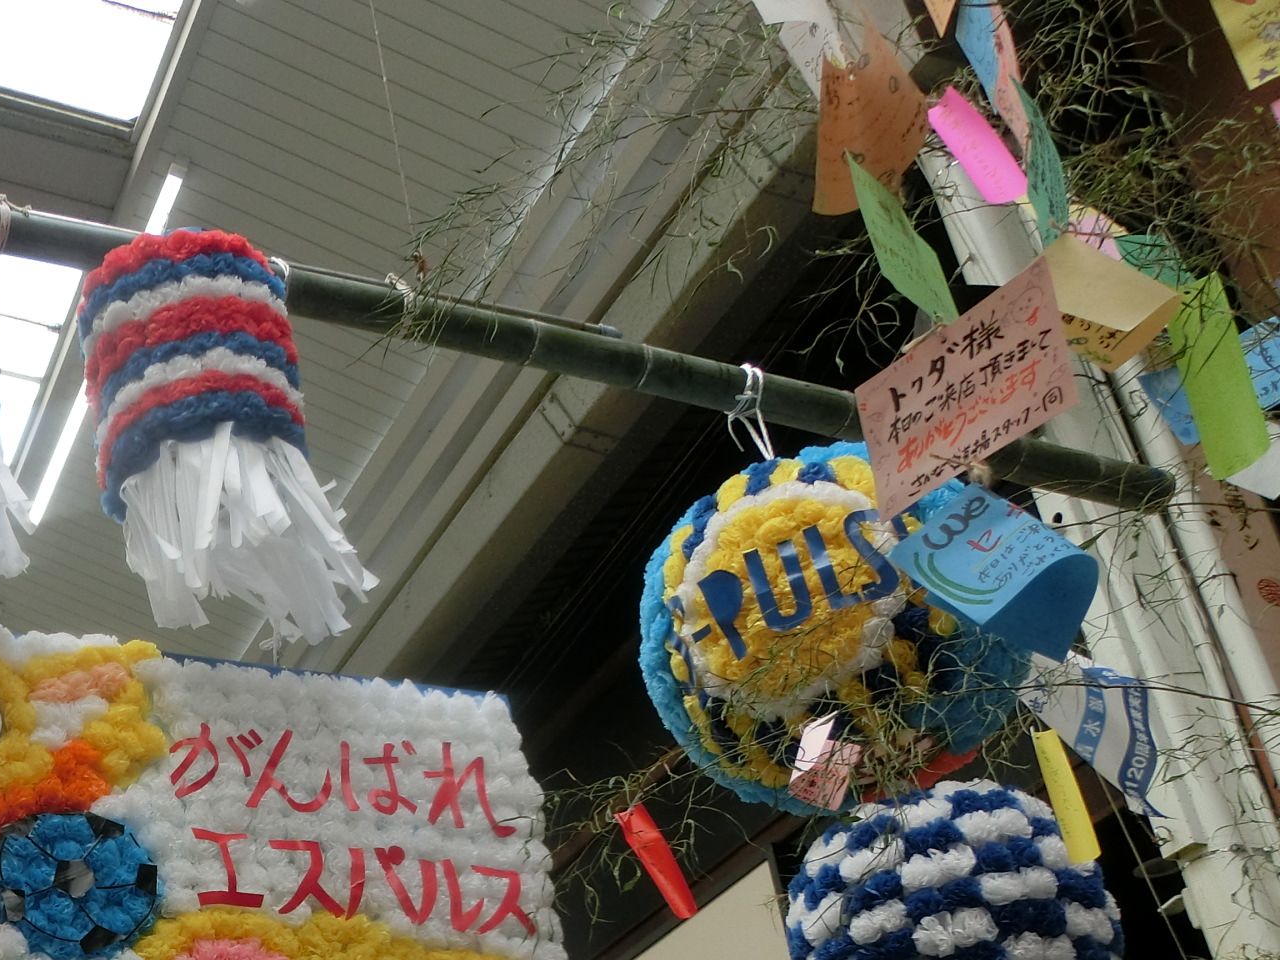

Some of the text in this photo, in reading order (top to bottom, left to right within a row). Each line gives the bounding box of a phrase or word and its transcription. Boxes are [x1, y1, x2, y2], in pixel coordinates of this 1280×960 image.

[169, 722, 517, 838] がんばれ
[192, 827, 537, 935] エスパルス
